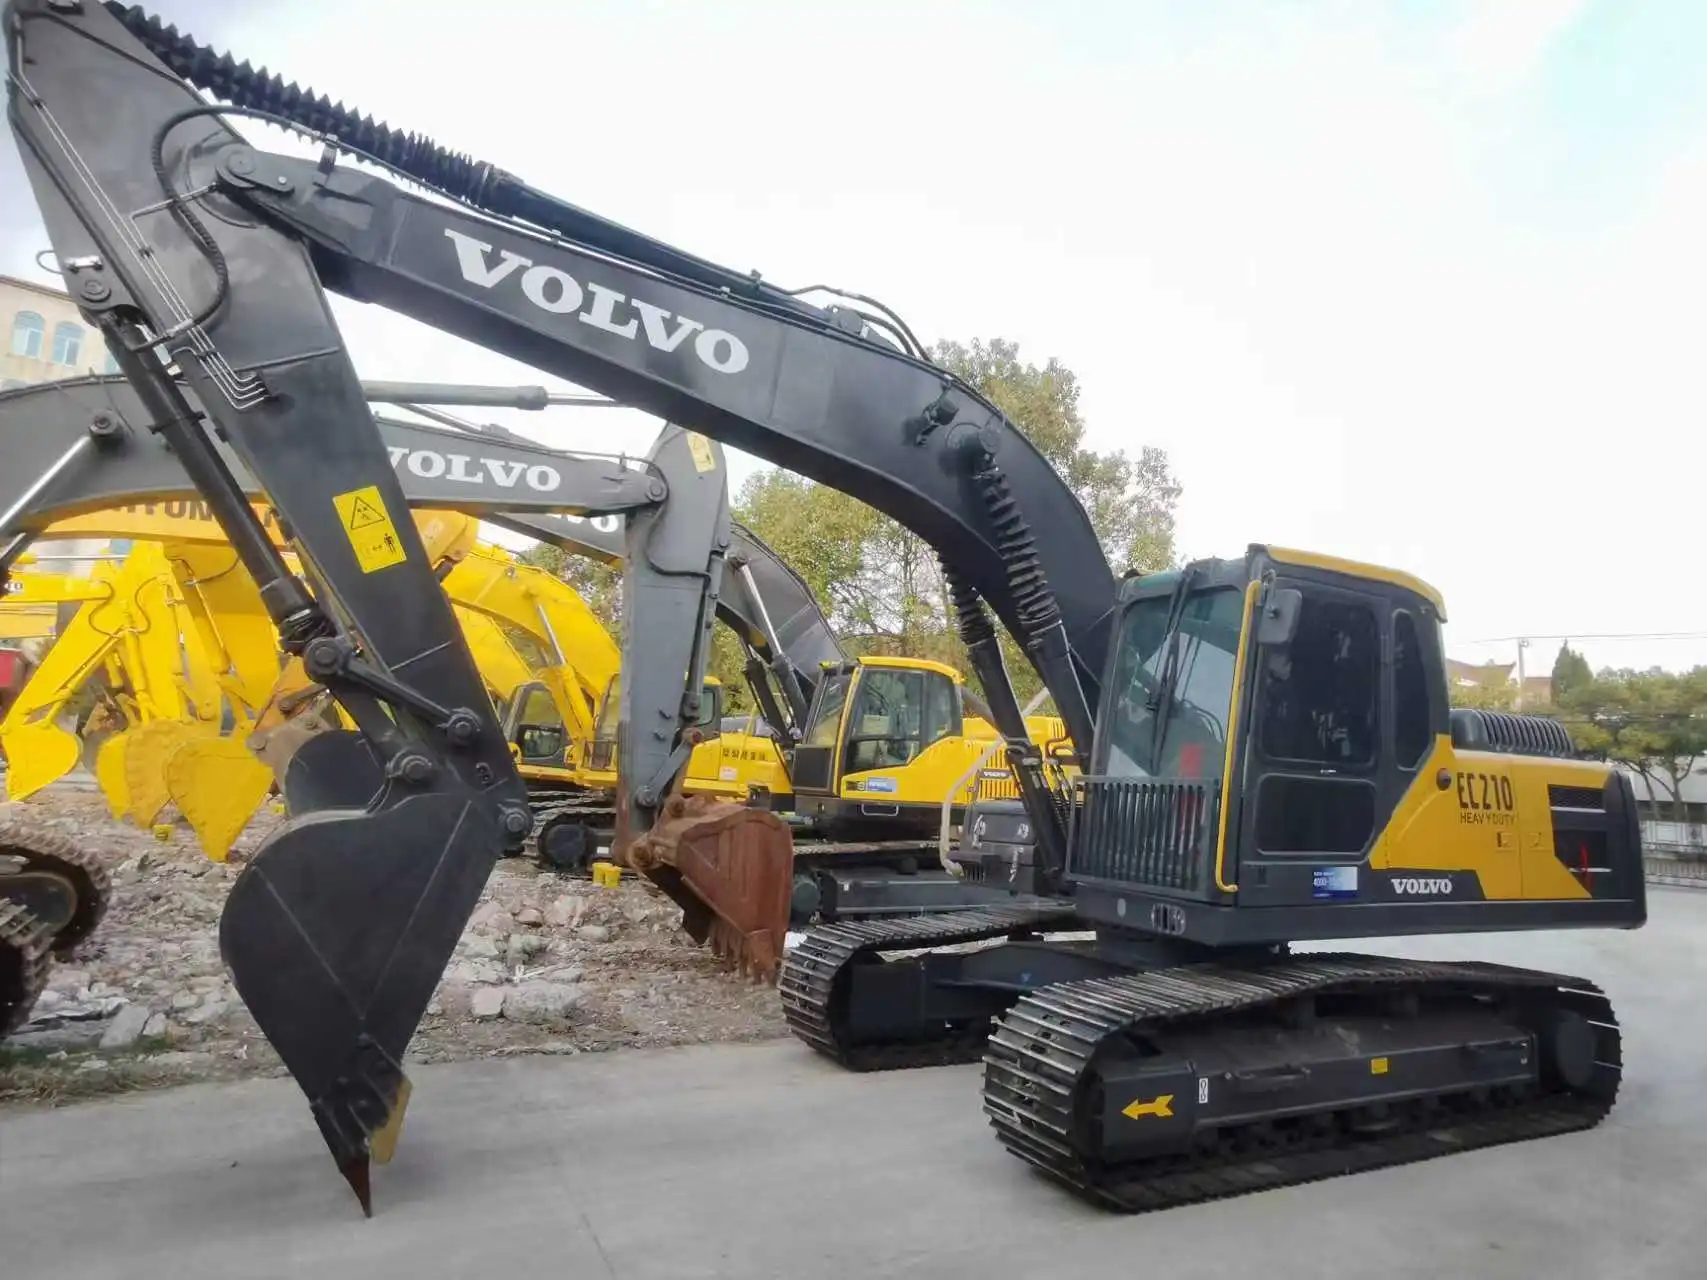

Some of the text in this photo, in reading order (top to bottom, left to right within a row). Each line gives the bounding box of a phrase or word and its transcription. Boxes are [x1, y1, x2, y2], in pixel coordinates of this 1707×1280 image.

[444, 228, 749, 374] VOLVO
[1457, 772, 1513, 811] EC210
[1391, 878, 1453, 894] VOLVO
